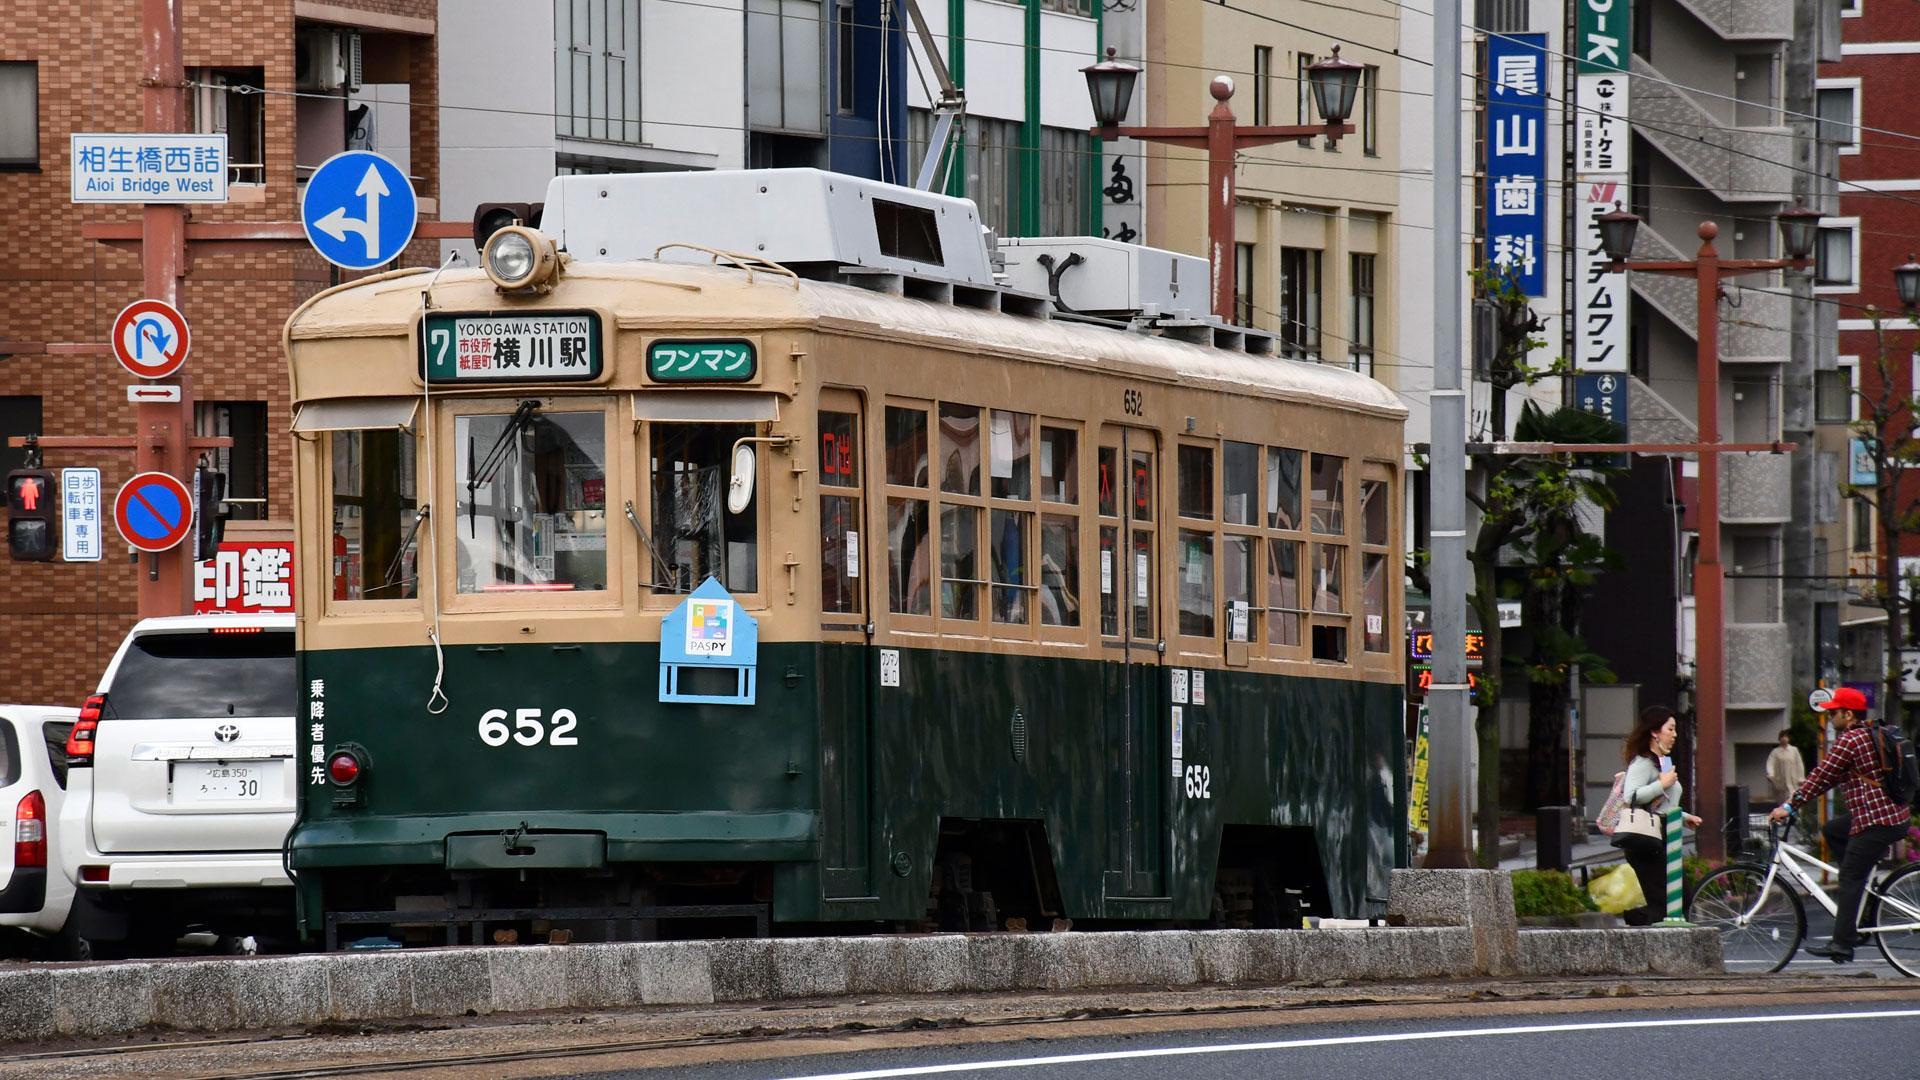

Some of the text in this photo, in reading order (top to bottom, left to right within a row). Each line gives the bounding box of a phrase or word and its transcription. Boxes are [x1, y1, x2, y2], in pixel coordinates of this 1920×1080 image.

[79, 146, 219, 173] 相生橋西詰
[1494, 55, 1538, 276] 尾山歯科
[86, 178, 214, 194] Aioi Bridge West
[458, 321, 587, 336] YOKOGAWA STATION
[431, 329, 449, 366] 7
[459, 338, 491, 353] 市役所
[493, 336, 587, 368] 横川駅
[655, 350, 747, 371] ワンマン
[459, 354, 491, 370] 紙屋町
[1124, 389, 1142, 416] 652
[68, 476, 80, 520] 自転車
[82, 476, 95, 520] 歩行者
[194, 548, 291, 607] 印鑑
[691, 640, 727, 651] PASPY
[310, 679, 325, 785] 乗降者優先
[478, 708, 578, 747] 652
[1186, 765, 1210, 799] 652
